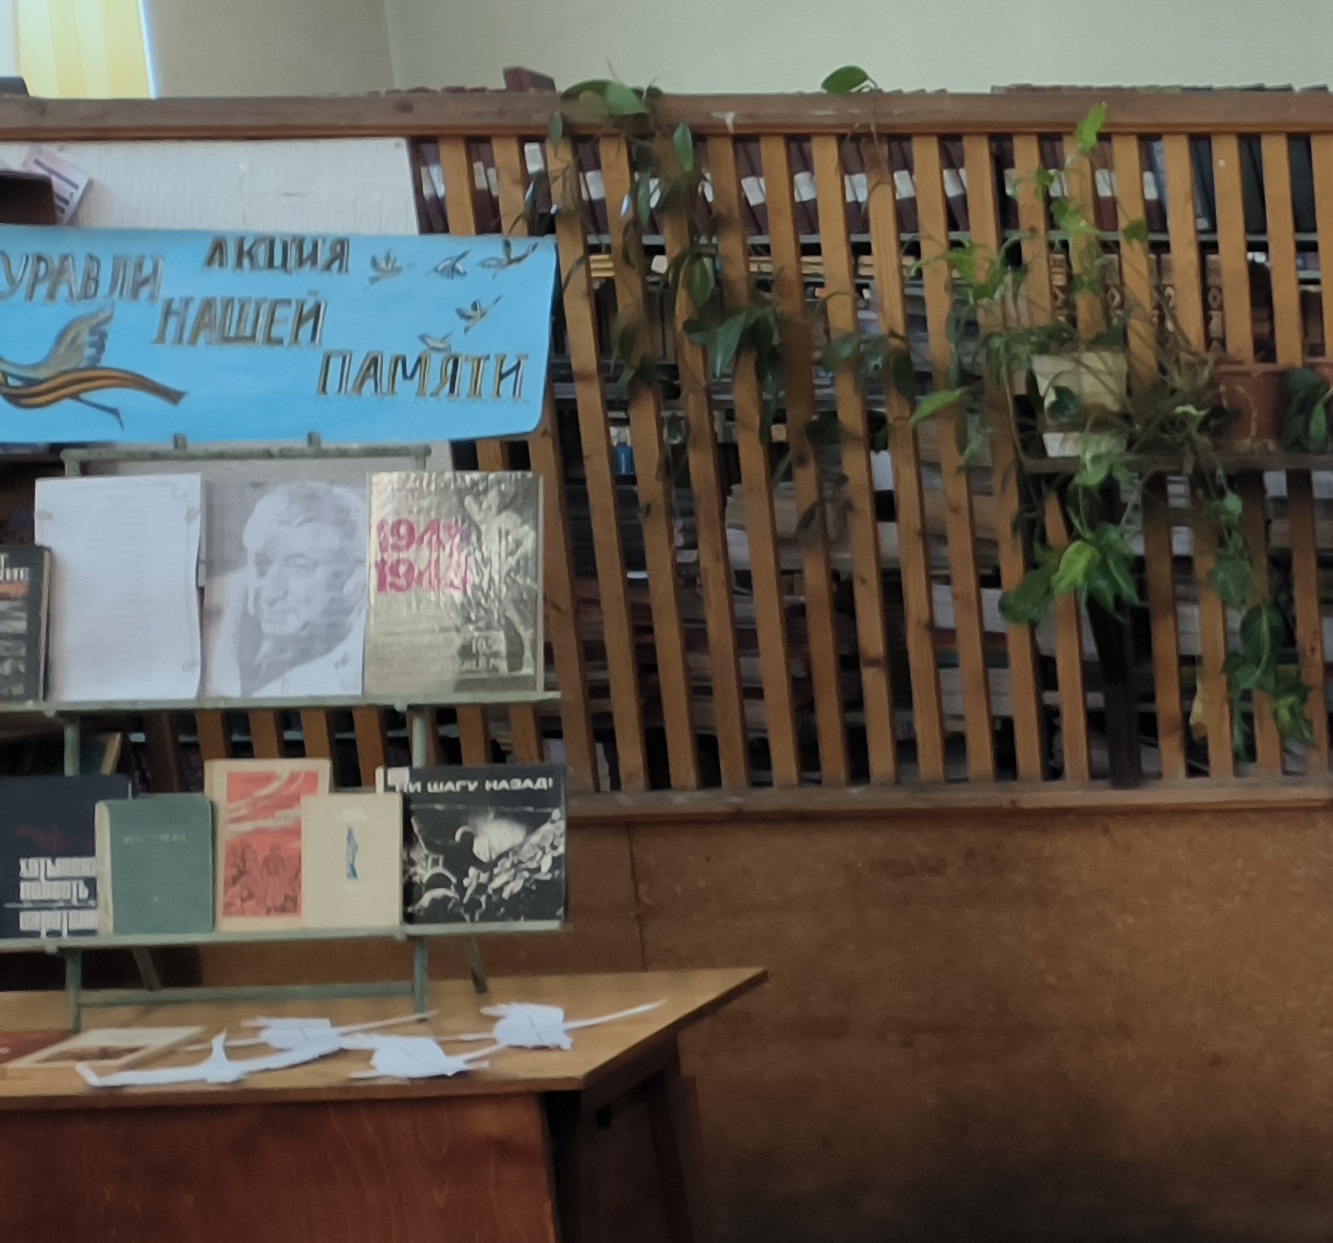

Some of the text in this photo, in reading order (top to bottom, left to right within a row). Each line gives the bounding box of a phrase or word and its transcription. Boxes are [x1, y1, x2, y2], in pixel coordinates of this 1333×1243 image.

[0, 250, 165, 302] УРАВЛИ
[204, 236, 350, 274] АКЦИЯ
[153, 291, 328, 347] НАШЕЙ
[318, 350, 529, 399] ПАМЯТИ
[427, 780, 478, 793] ШАГУ
[485, 777, 553, 791] НАЗАД!
